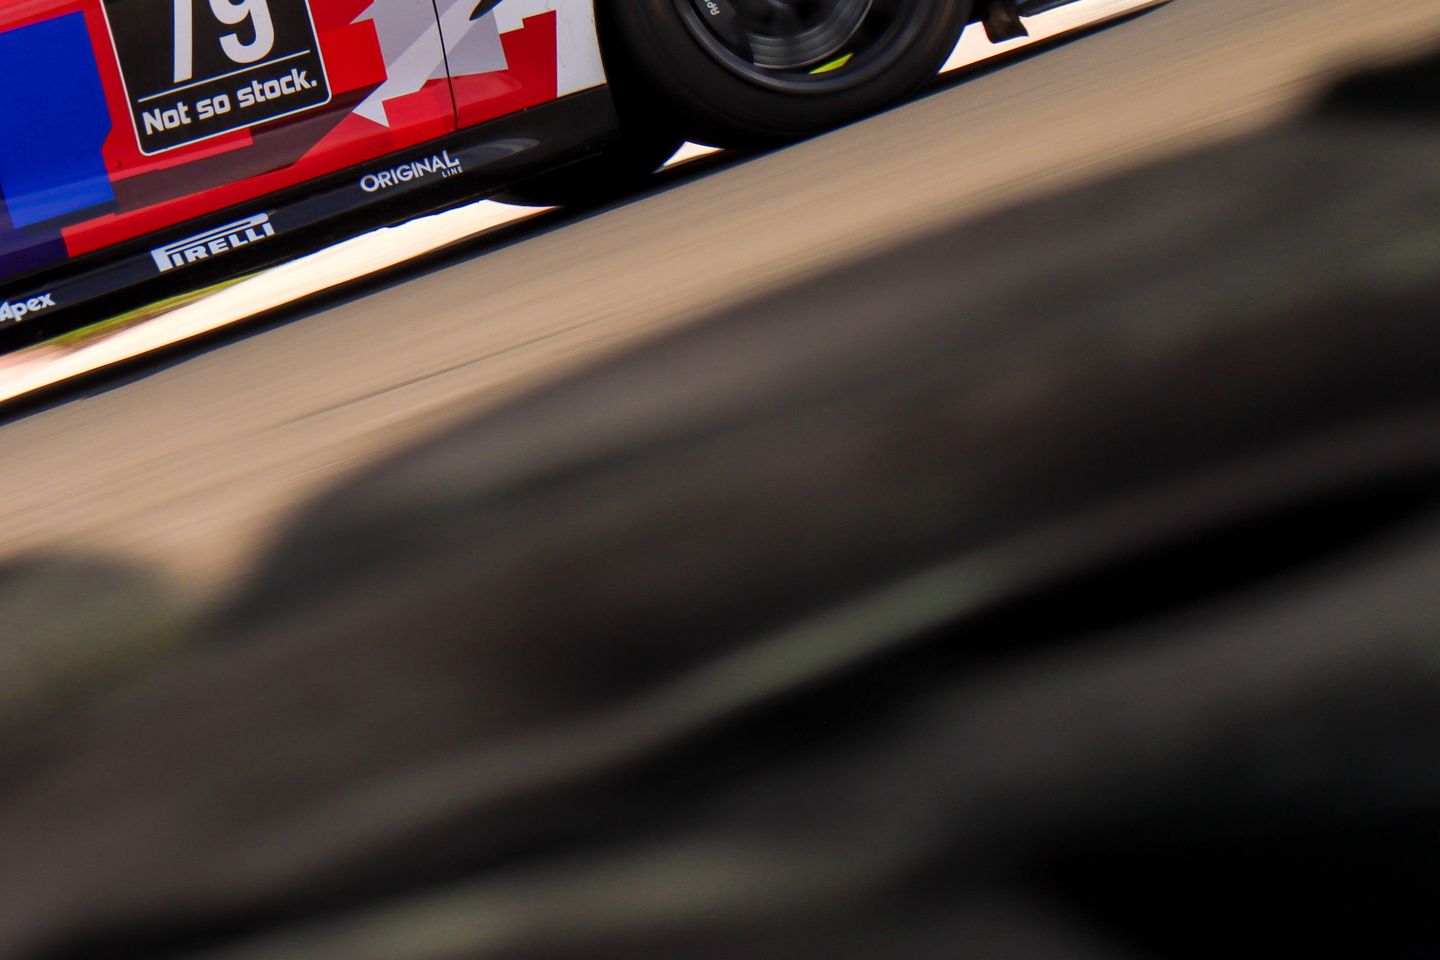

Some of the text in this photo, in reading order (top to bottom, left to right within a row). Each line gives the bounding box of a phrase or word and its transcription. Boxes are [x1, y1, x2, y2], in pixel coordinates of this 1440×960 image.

[142, 68, 318, 136] Not so stock.
[360, 150, 460, 192] ORIGINAL
[441, 165, 463, 178] LINE
[150, 212, 276, 272] PIRELLI
